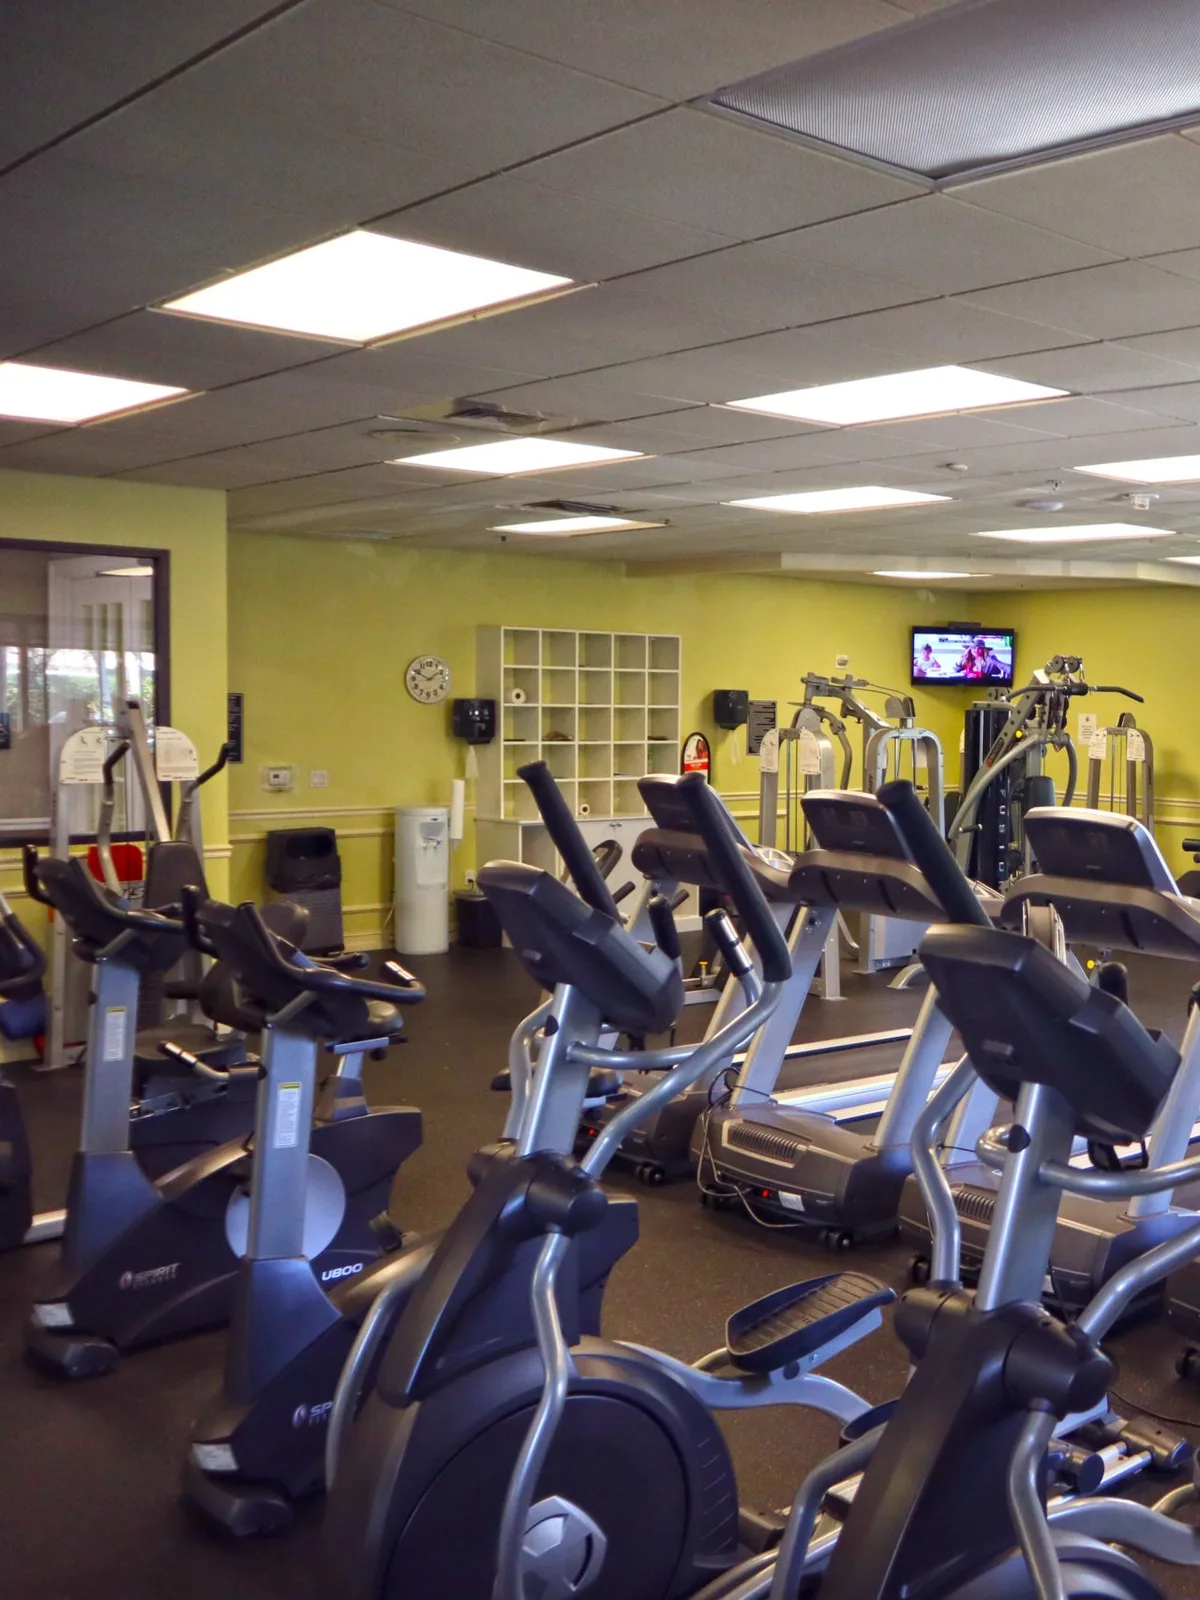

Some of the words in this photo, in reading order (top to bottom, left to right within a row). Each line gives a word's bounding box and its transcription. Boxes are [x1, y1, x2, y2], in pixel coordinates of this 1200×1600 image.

[998, 788, 1006, 884] FUSIO
[134, 1262, 180, 1281] SPIRIT
[322, 1263, 363, 1281] U800
